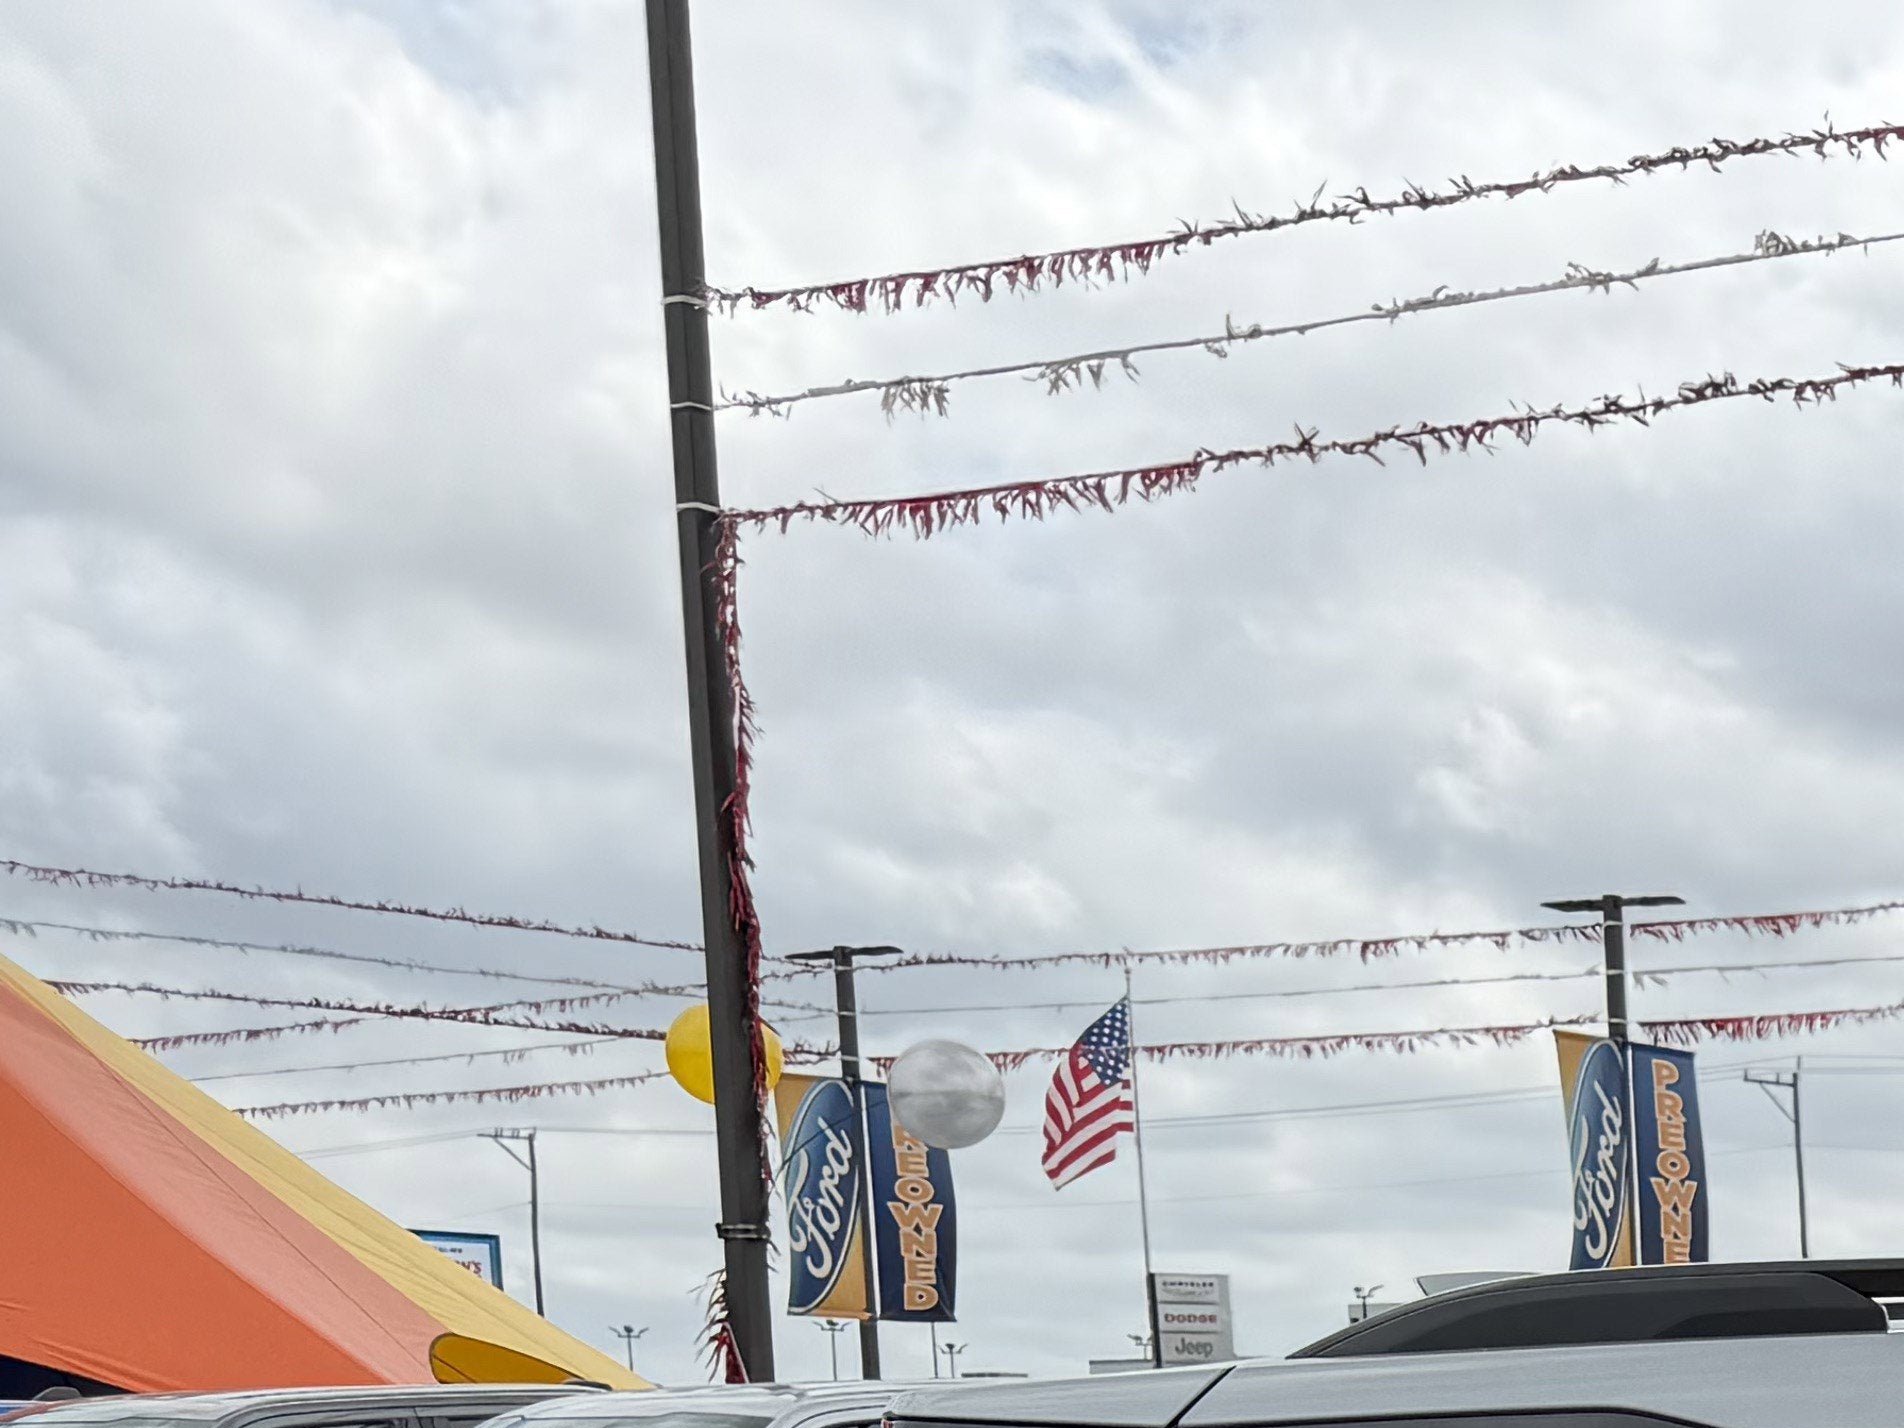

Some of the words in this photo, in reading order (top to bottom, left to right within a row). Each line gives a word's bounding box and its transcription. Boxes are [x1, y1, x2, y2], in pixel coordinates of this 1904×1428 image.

[789, 1115, 853, 1279] Ford
[886, 1119, 944, 1312] REOWNED
[1573, 1079, 1623, 1261] Ford
[1650, 1058, 1698, 1264] PREOWNE
[1163, 1312, 1218, 1324] DODGE
[1174, 1336, 1214, 1359] Jeep
